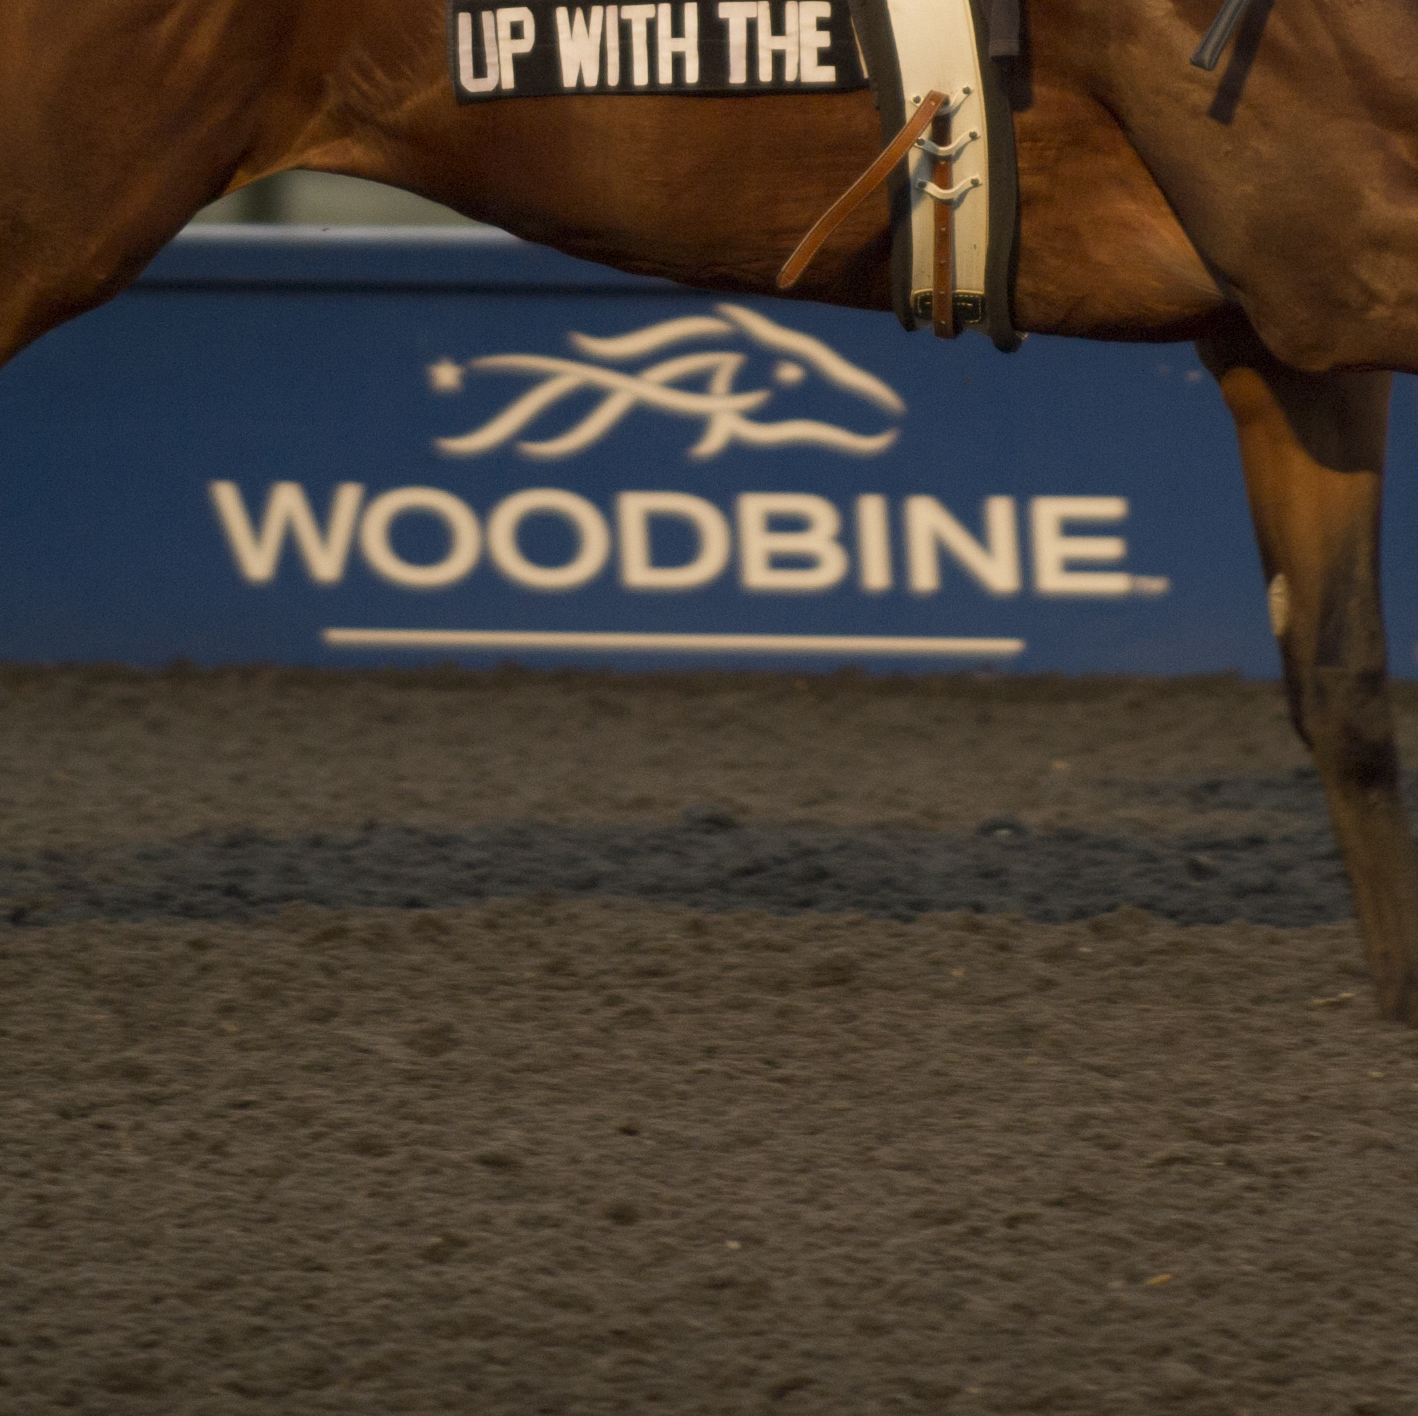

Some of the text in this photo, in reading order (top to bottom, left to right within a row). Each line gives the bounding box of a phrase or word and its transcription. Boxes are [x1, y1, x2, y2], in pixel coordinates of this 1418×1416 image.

[458, 0, 836, 92] UP WITH THE
[212, 482, 1136, 596] WOODBINE
